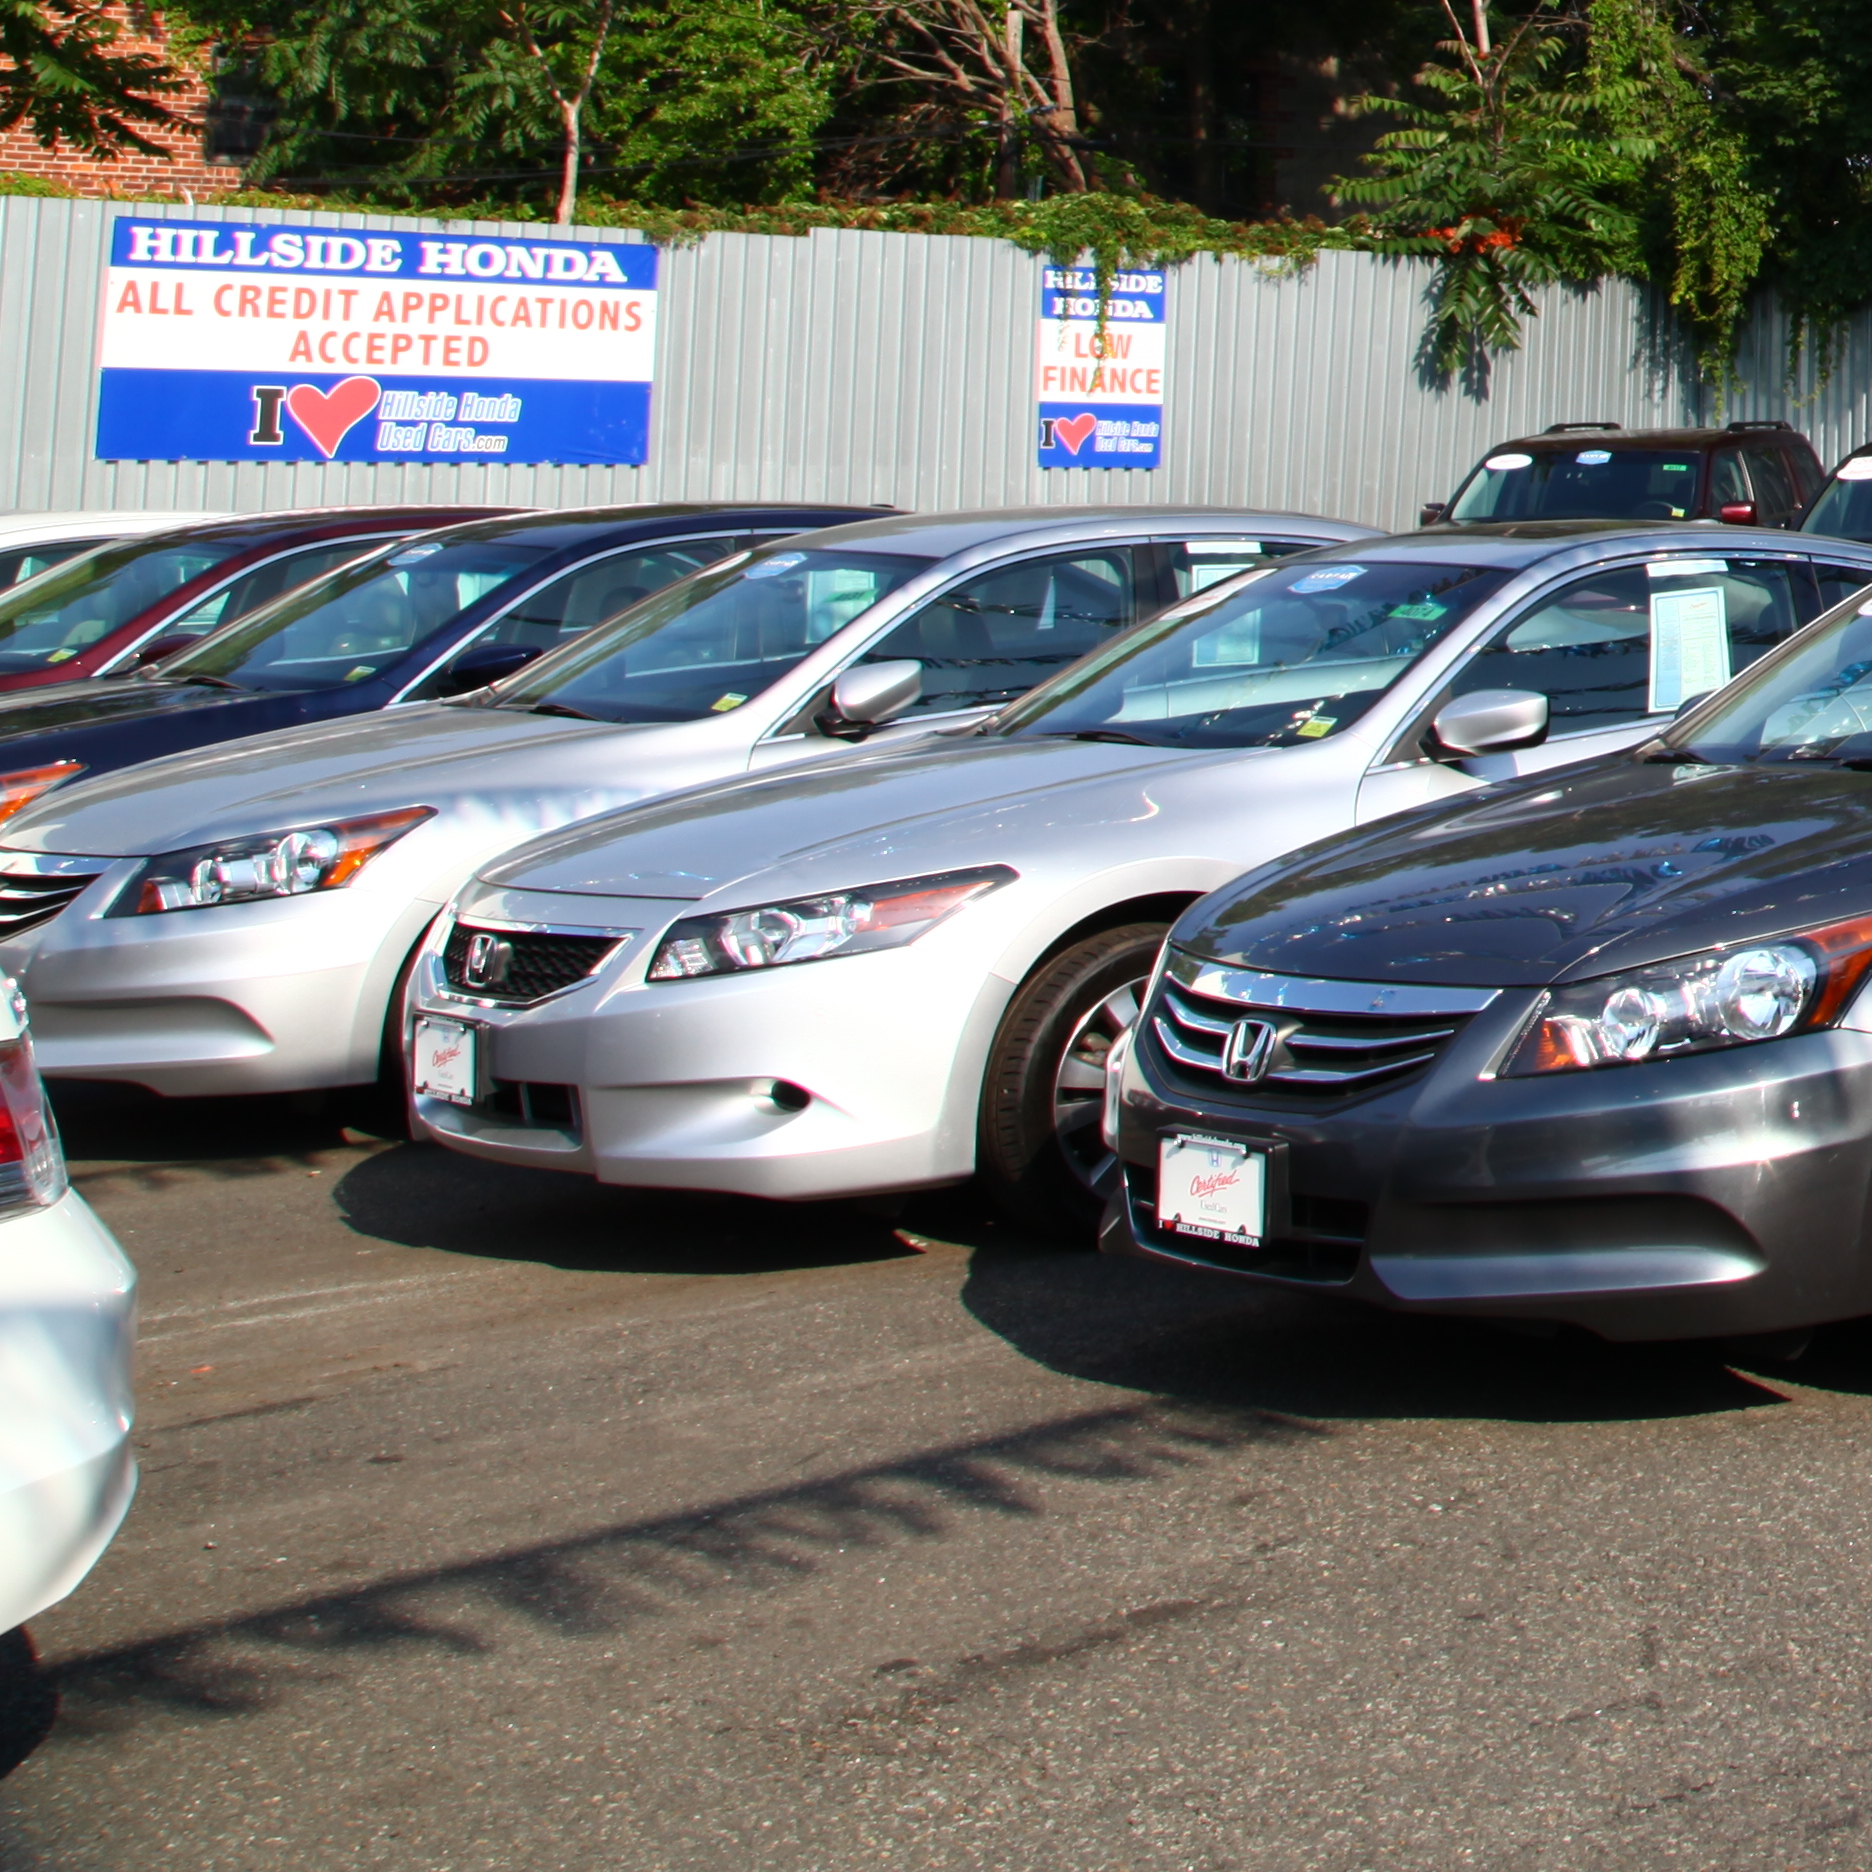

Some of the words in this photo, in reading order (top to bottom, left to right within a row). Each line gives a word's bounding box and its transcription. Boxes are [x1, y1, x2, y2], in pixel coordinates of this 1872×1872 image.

[128, 226, 402, 273] HILLSIDE
[420, 241, 628, 283] HONDA
[116, 280, 194, 316] ALL
[213, 283, 361, 322] CREDIT
[372, 290, 644, 333] APPLICATIONS
[288, 330, 491, 368] ACCEPTED
[1042, 366, 1161, 395] FINANCE
[250, 386, 287, 445] I
[378, 391, 458, 420] Hillside
[458, 392, 522, 422] Honda
[377, 422, 427, 450] Used
[1190, 1170, 1240, 1197] Certified
[1176, 1223, 1221, 1240] HILLSIDE
[1224, 1232, 1260, 1247] HONDA
